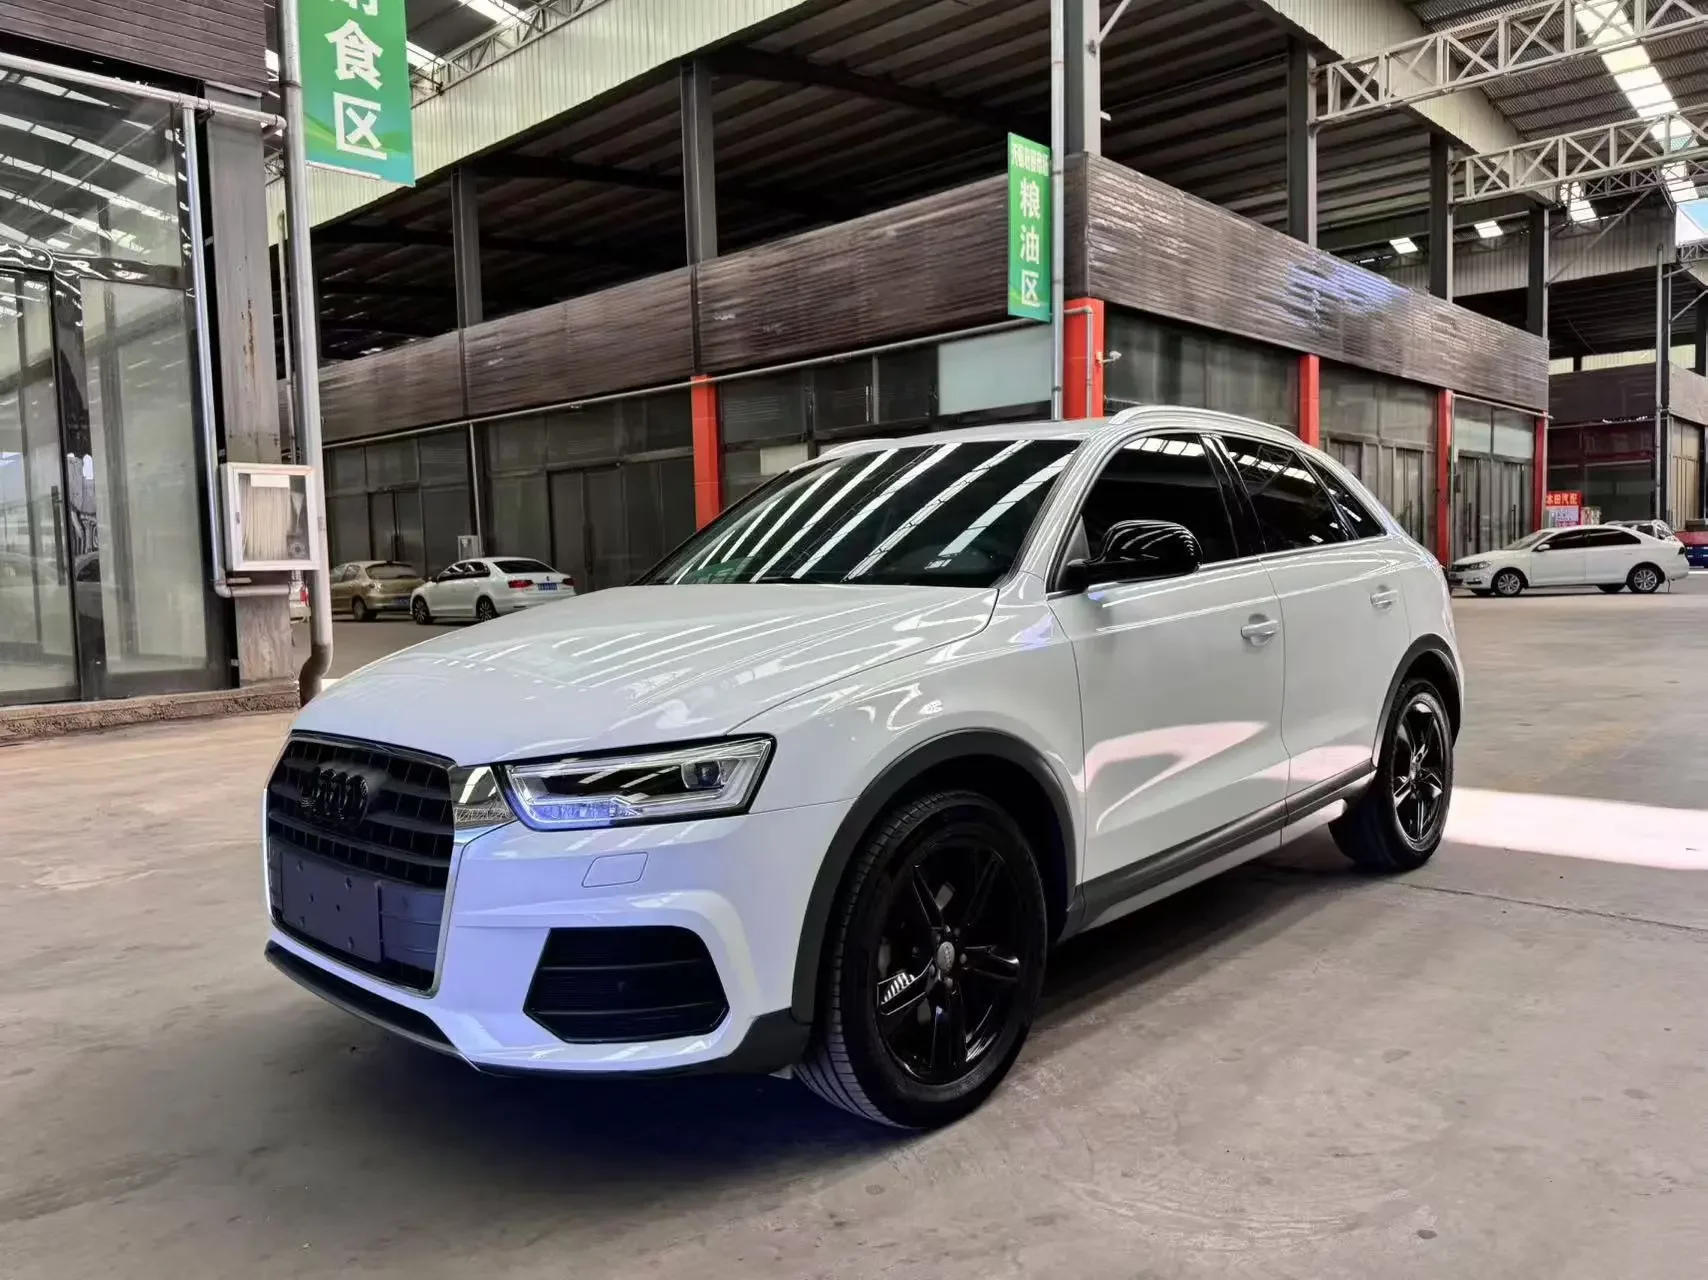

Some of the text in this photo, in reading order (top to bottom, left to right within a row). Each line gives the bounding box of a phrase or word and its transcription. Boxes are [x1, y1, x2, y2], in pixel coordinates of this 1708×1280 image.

[324, 0, 388, 161] 食区
[1020, 176, 1040, 308] 粮油区
